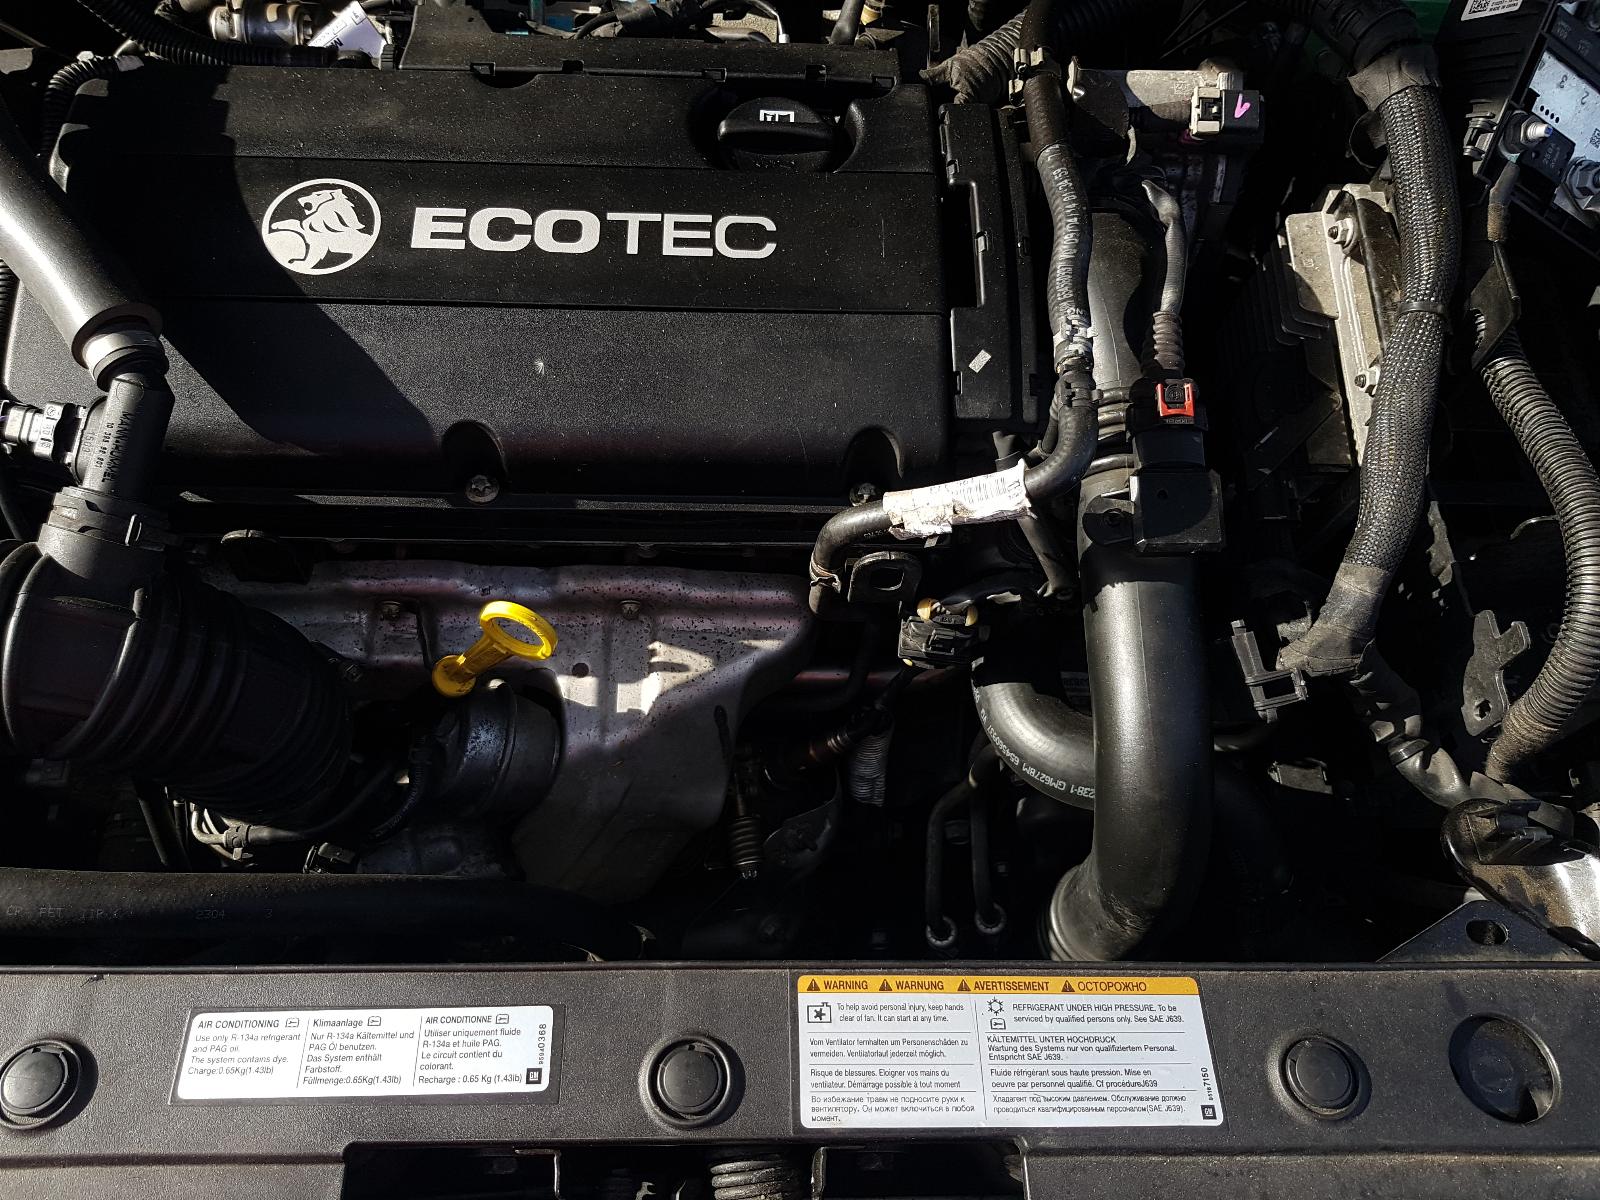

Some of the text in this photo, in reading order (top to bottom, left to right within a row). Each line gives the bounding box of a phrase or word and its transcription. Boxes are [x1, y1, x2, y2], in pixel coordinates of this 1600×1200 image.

[410, 207, 778, 259] ECOTEC
[823, 980, 868, 991] WARNING
[894, 980, 944, 991] WARNUNG
[973, 980, 1050, 991] AVERTISSEMENT
[1077, 980, 1147, 992] ОСТОРОЖНО
[836, 1002, 845, 1011] To
[845, 1002, 860, 1012] help
[860, 1002, 878, 1012] avoid
[879, 1002, 907, 1012] personal
[927, 1002, 944, 1012] keep
[944, 1002, 964, 1011] hands
[1012, 1003, 1064, 1012] REFRIGERANT
[1065, 1003, 1093, 1012] UNDER
[1093, 1002, 1113, 1012] HIGH
[1158, 1003, 1166, 1012] To
[1168, 1003, 1177, 1012] be
[312, 1018, 363, 1028] Klimaanlage
[425, 1016, 438, 1024] AIR
[839, 1013, 855, 1022] clear
[856, 1013, 863, 1022] of
[896, 1013, 911, 1022] start
[920, 1015, 932, 1023] any
[1013, 1013, 1184, 1024] serviced by qualified persons only. See SAE J639.
[197, 1019, 279, 1029] AIR CONDITIONING
[310, 1030, 414, 1040] Nur R-134a Kältemittel und
[424, 1027, 521, 1038] Utiliser uniquement fluide
[212, 1034, 228, 1043] only
[230, 1033, 258, 1041] R-134a
[422, 1038, 502, 1048] R-134a et huile PAG.
[809, 1037, 824, 1046] Vom
[824, 1037, 855, 1046] Ventilator
[1038, 1035, 1066, 1044] UNTER
[1066, 1035, 1117, 1044] HOCHDRUCK
[209, 1044, 227, 1052] PAG
[308, 1042, 326, 1051] PAG
[338, 1042, 376, 1051] benutzen.
[987, 1044, 1018, 1053] Wartung
[1034, 1044, 1065, 1053] Systems
[1094, 1043, 1143, 1053] qualifiziertem
[306, 1053, 382, 1063] Das System enthält
[421, 1051, 431, 1059] Le
[432, 1050, 457, 1059] circuit
[492, 1049, 503, 1058] du
[889, 1049, 918, 1059] jederzeit
[988, 1052, 1064, 1061] Entspricht SAE J639.
[191, 1055, 288, 1065] The system contains dye.
[304, 1064, 342, 1074] Farbstoff.
[419, 1062, 454, 1070] colorant.
[810, 1068, 833, 1078] Risque
[834, 1068, 843, 1076] de
[919, 1068, 940, 1077] mains
[940, 1068, 950, 1077] du
[989, 1068, 1012, 1077] Fluide
[1069, 1067, 1090, 1078] haute
[1124, 1068, 1142, 1076] Mise
[418, 1075, 456, 1085] Recharge
[481, 1074, 492, 1084] Kg
[884, 1079, 912, 1090] possible
[919, 1080, 932, 1088] tout
[933, 1080, 961, 1088] moment
[1016, 1081, 1029, 1090] par
[1030, 1079, 1066, 1089] personnel
